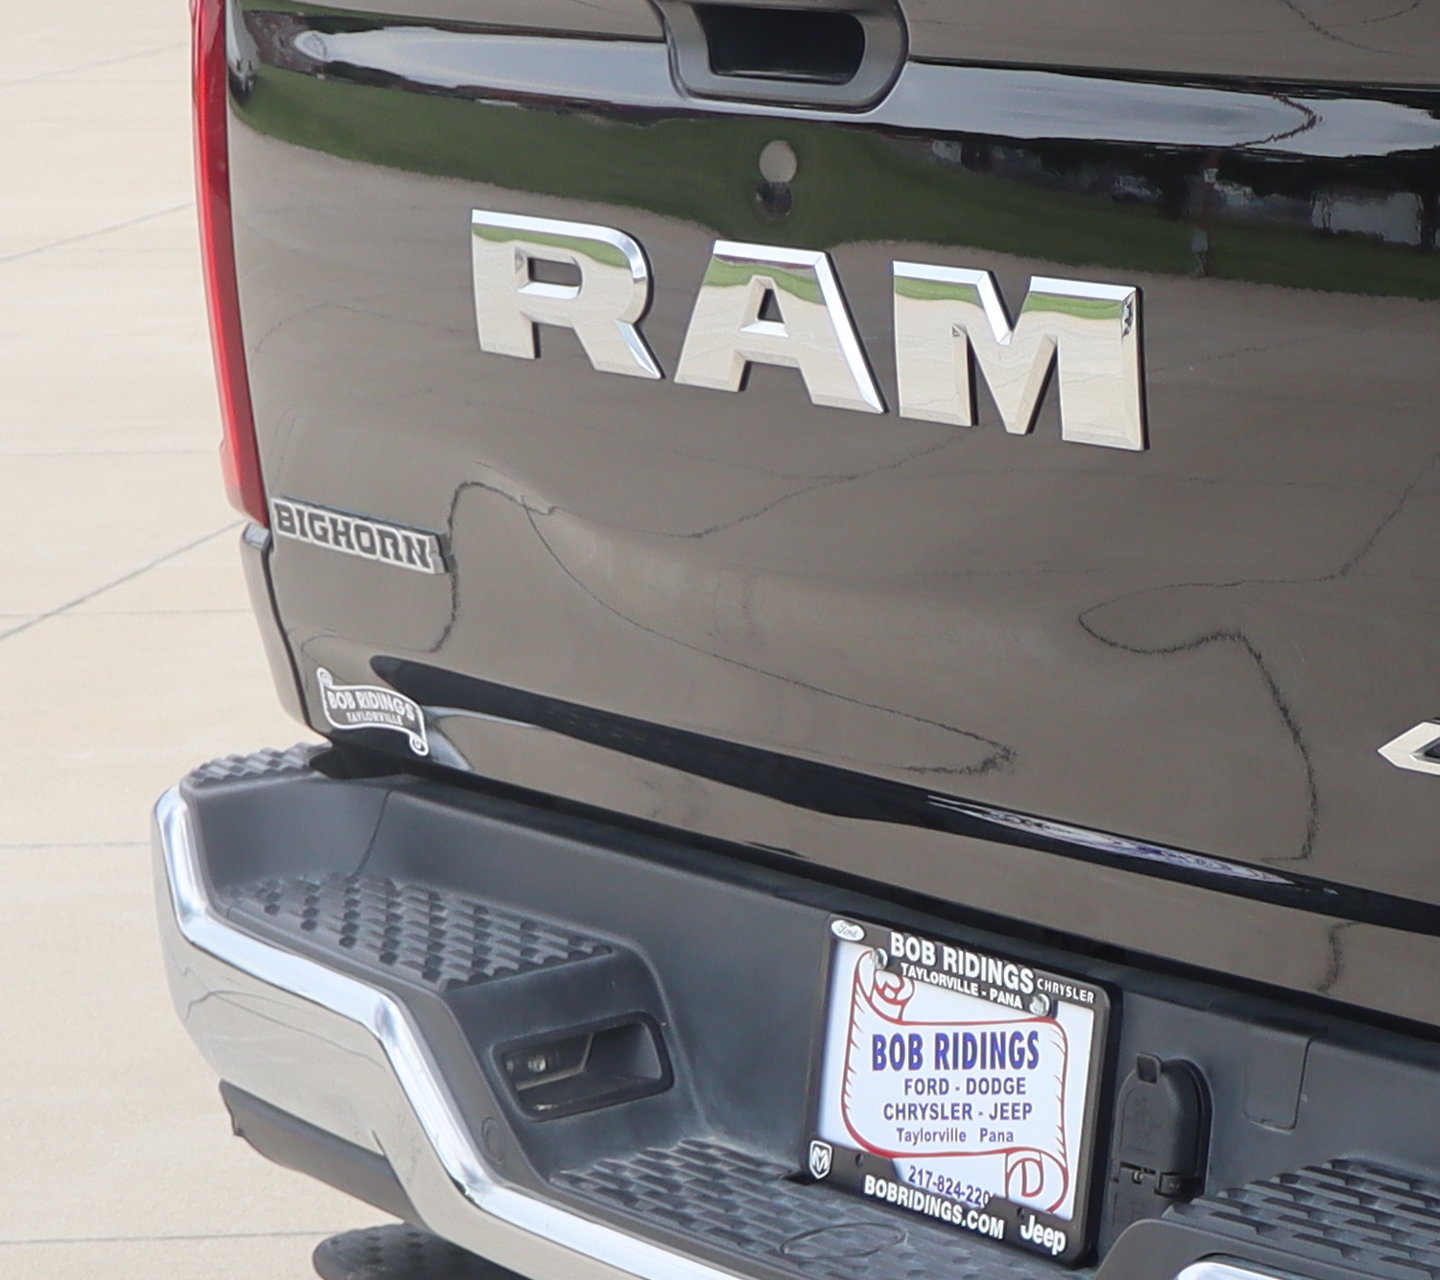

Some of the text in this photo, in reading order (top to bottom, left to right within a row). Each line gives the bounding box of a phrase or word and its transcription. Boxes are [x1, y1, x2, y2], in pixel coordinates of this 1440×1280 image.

[470, 208, 1148, 452] RAM
[272, 499, 438, 573] BIGHORN
[326, 689, 416, 722] BOB RIDINGS
[346, 711, 404, 727] TAYLORVILLE
[890, 931, 1035, 995] BOB RIDINGS
[900, 962, 979, 998] TAYLORVILLE
[989, 986, 1024, 1010] PANA
[1036, 977, 1096, 1005] CHRYSLER
[872, 1029, 1041, 1072] BOB RIDINGS
[903, 1077, 950, 1096] FORD
[965, 1076, 1028, 1096] DODGE
[883, 1102, 973, 1121] CHRYSLER
[988, 1102, 1033, 1121] JEEP
[896, 1127, 1015, 1146] Taylorville Pana
[863, 1174, 1006, 1241] BOBRIDINGS.COM
[908, 1165, 997, 1208] 217-824-220
[1020, 1214, 1067, 1256] Jeep
